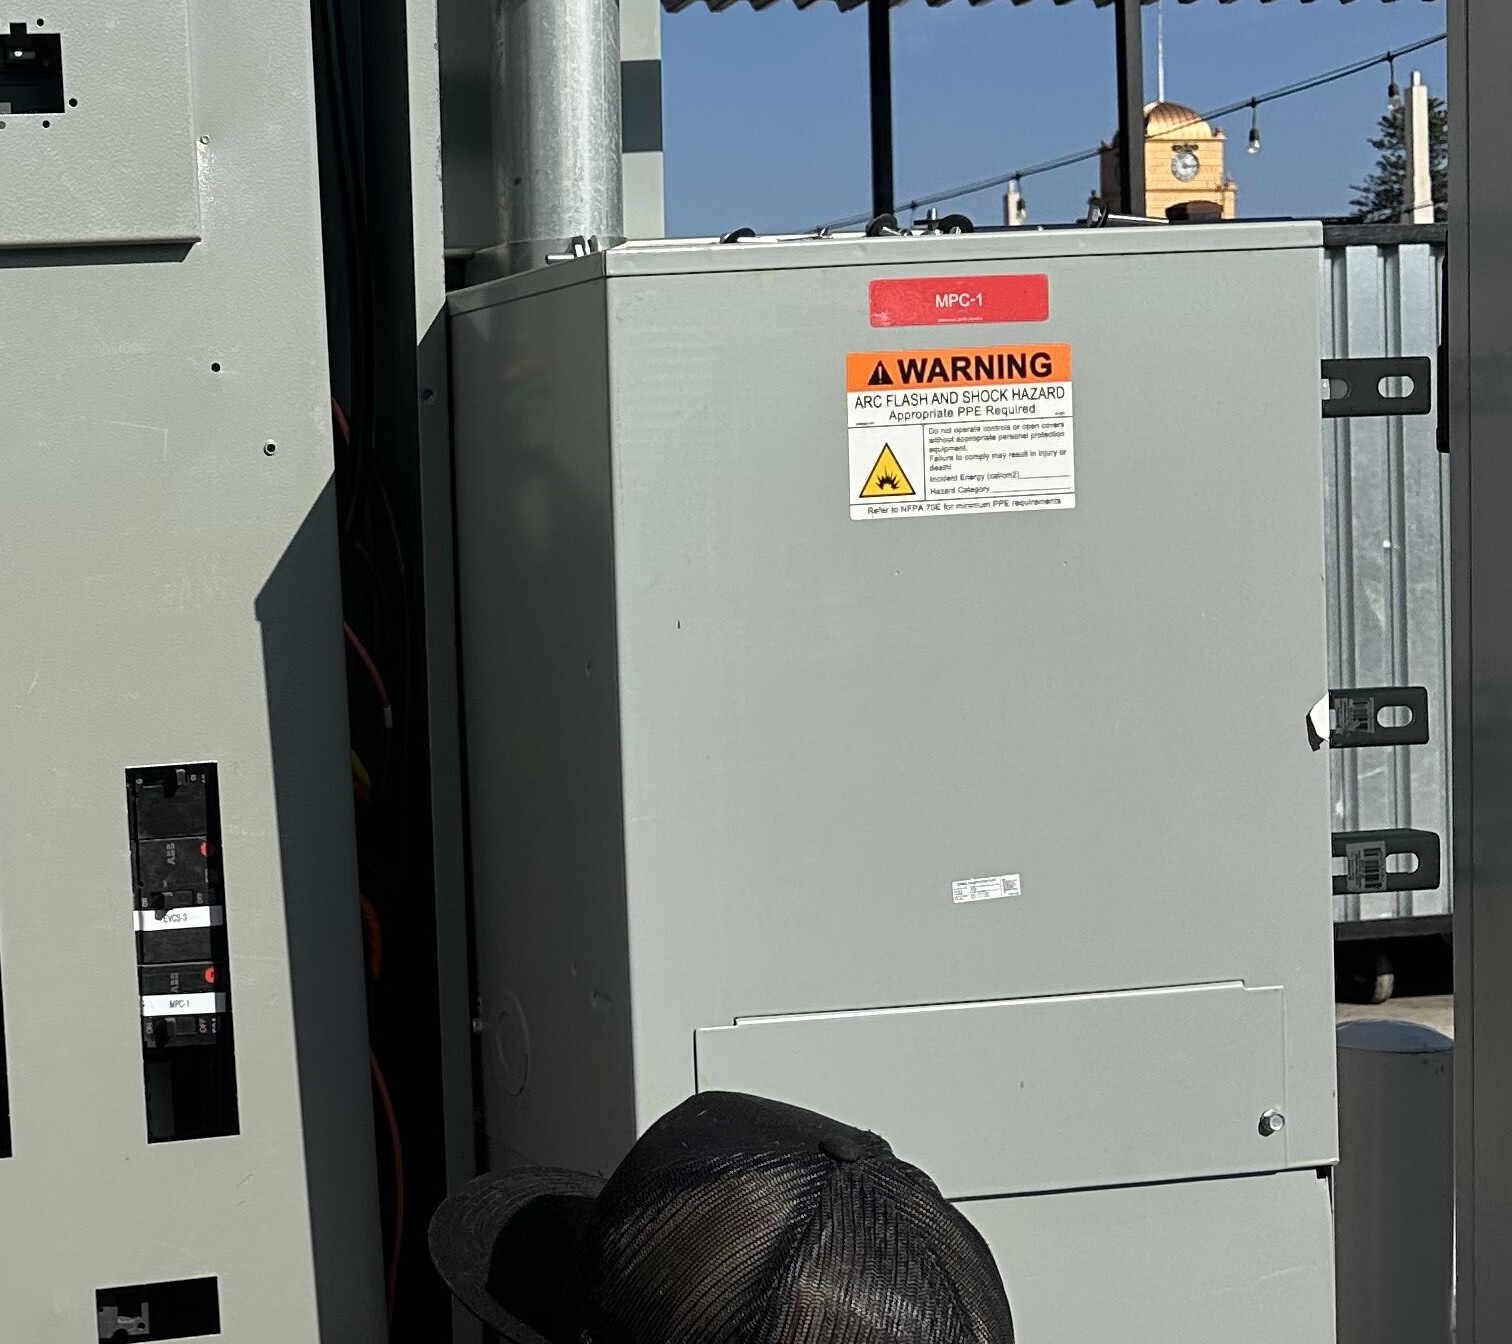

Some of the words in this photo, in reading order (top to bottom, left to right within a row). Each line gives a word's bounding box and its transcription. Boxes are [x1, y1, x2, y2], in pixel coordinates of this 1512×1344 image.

[935, 293, 983, 308] MPC-1
[897, 352, 1053, 384] WARNING
[854, 395, 882, 409] ARC
[886, 392, 928, 407] FLASH
[931, 391, 959, 405] AND
[962, 388, 1009, 404] SHOCK
[1012, 386, 1065, 401] HAZARD
[889, 408, 954, 422] Appropriate
[957, 406, 981, 417] PPE
[985, 404, 1036, 417] Required
